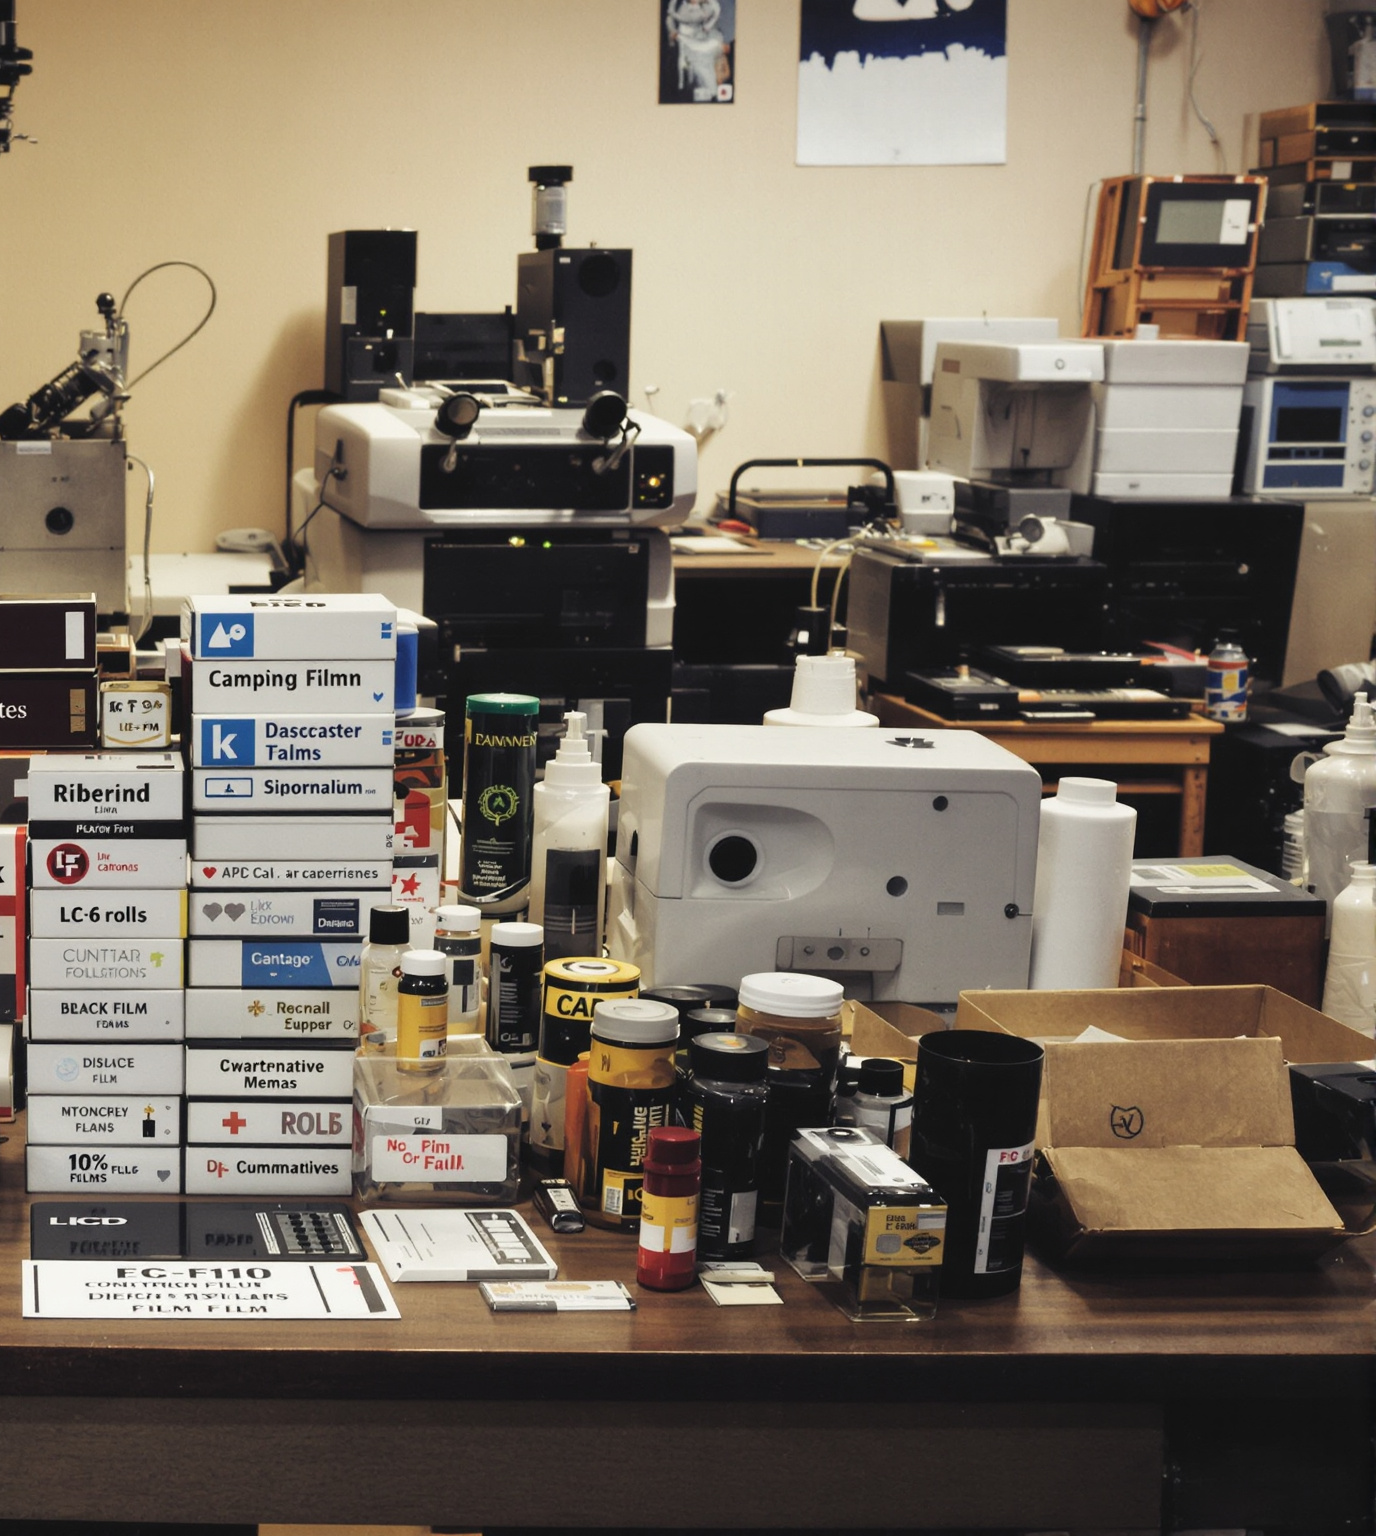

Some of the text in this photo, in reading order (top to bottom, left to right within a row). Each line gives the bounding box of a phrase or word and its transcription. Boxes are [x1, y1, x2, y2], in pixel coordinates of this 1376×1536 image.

[209, 670, 297, 691] Camping
[54, 783, 150, 803] Riberind
[60, 906, 147, 922] LC-6 rolls
[113, 1002, 148, 1014] FILM
[244, 1076, 297, 1089] Memas
[387, 1139, 406, 1152] No
[68, 1153, 108, 1171] 10%
